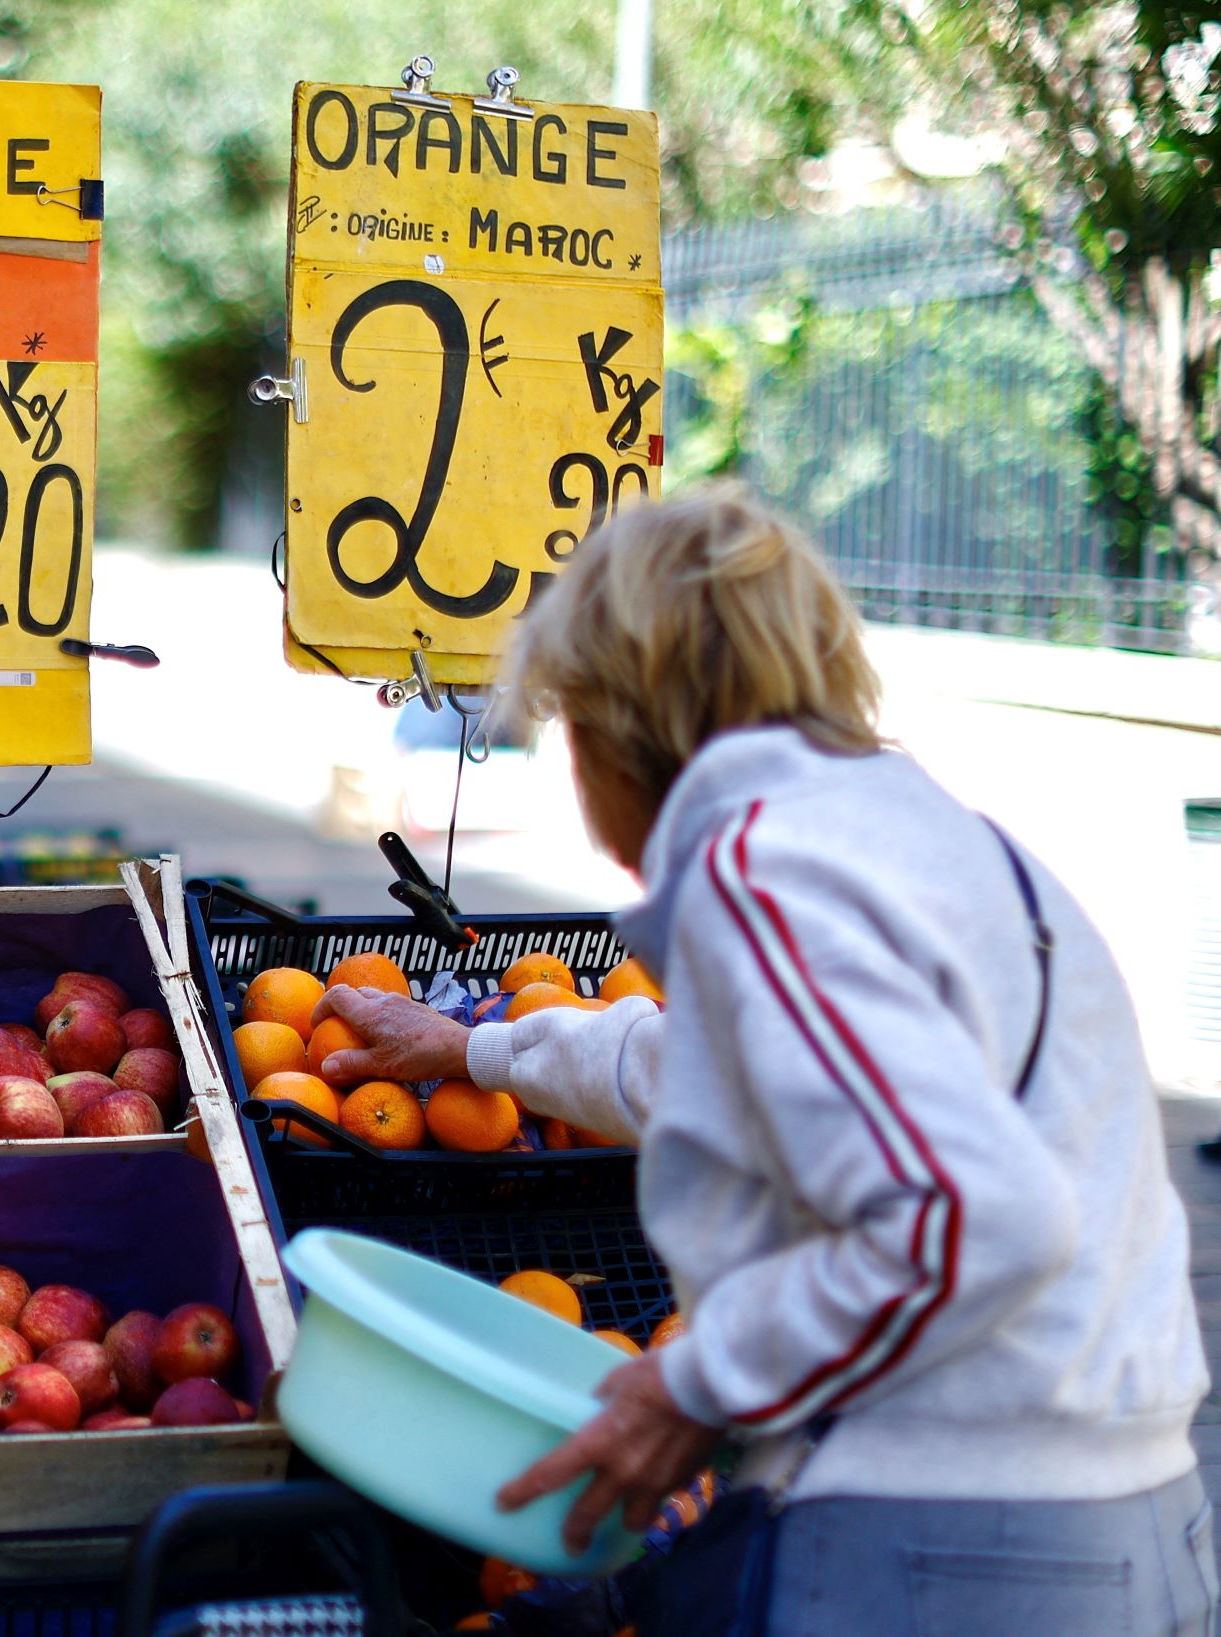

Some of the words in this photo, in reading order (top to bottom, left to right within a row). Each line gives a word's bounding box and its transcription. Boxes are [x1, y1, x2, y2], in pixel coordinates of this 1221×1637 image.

[306, 89, 629, 190] ORANGE
[469, 207, 615, 270] MAROC
[577, 326, 660, 450] Kg
